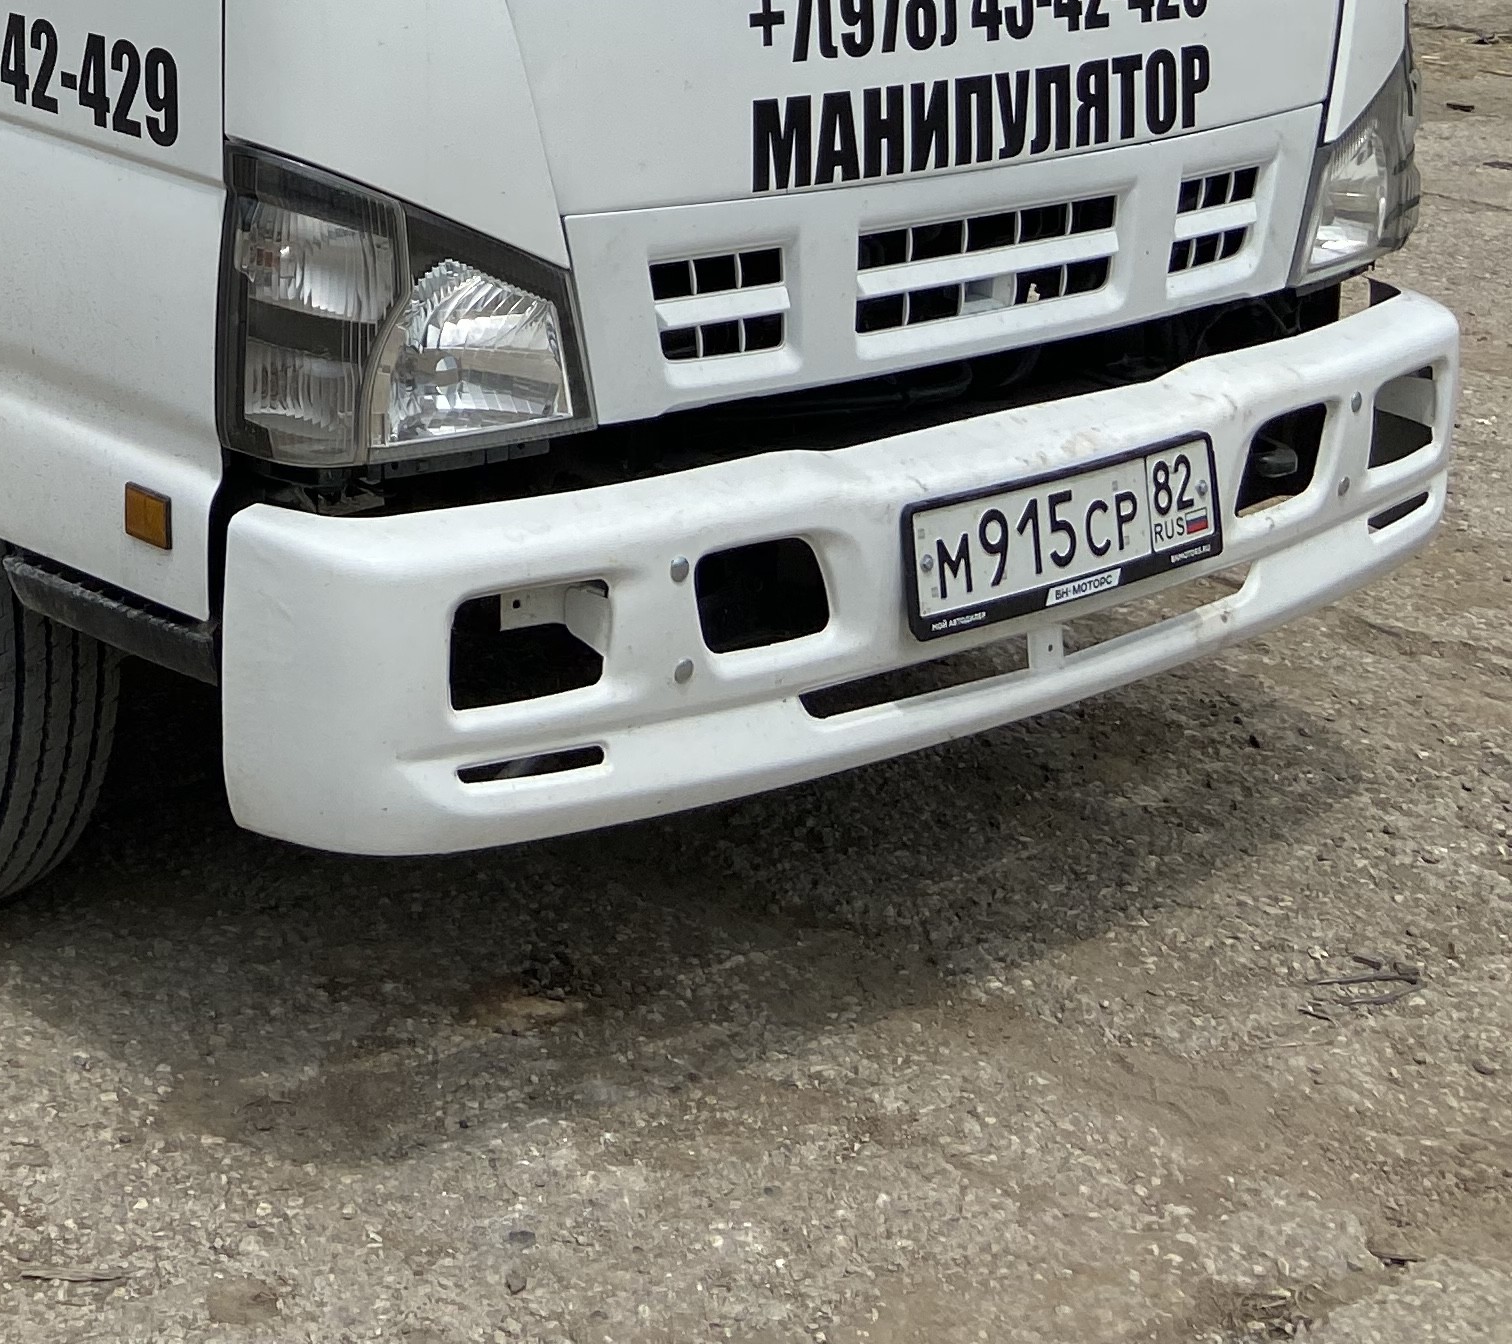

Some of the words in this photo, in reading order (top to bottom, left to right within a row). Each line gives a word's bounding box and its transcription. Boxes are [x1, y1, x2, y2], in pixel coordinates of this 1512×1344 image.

[752, 44, 1210, 193] МАНИПУЛЯТОР
[1152, 454, 1194, 516] 82
[1153, 516, 1186, 544] RUS
